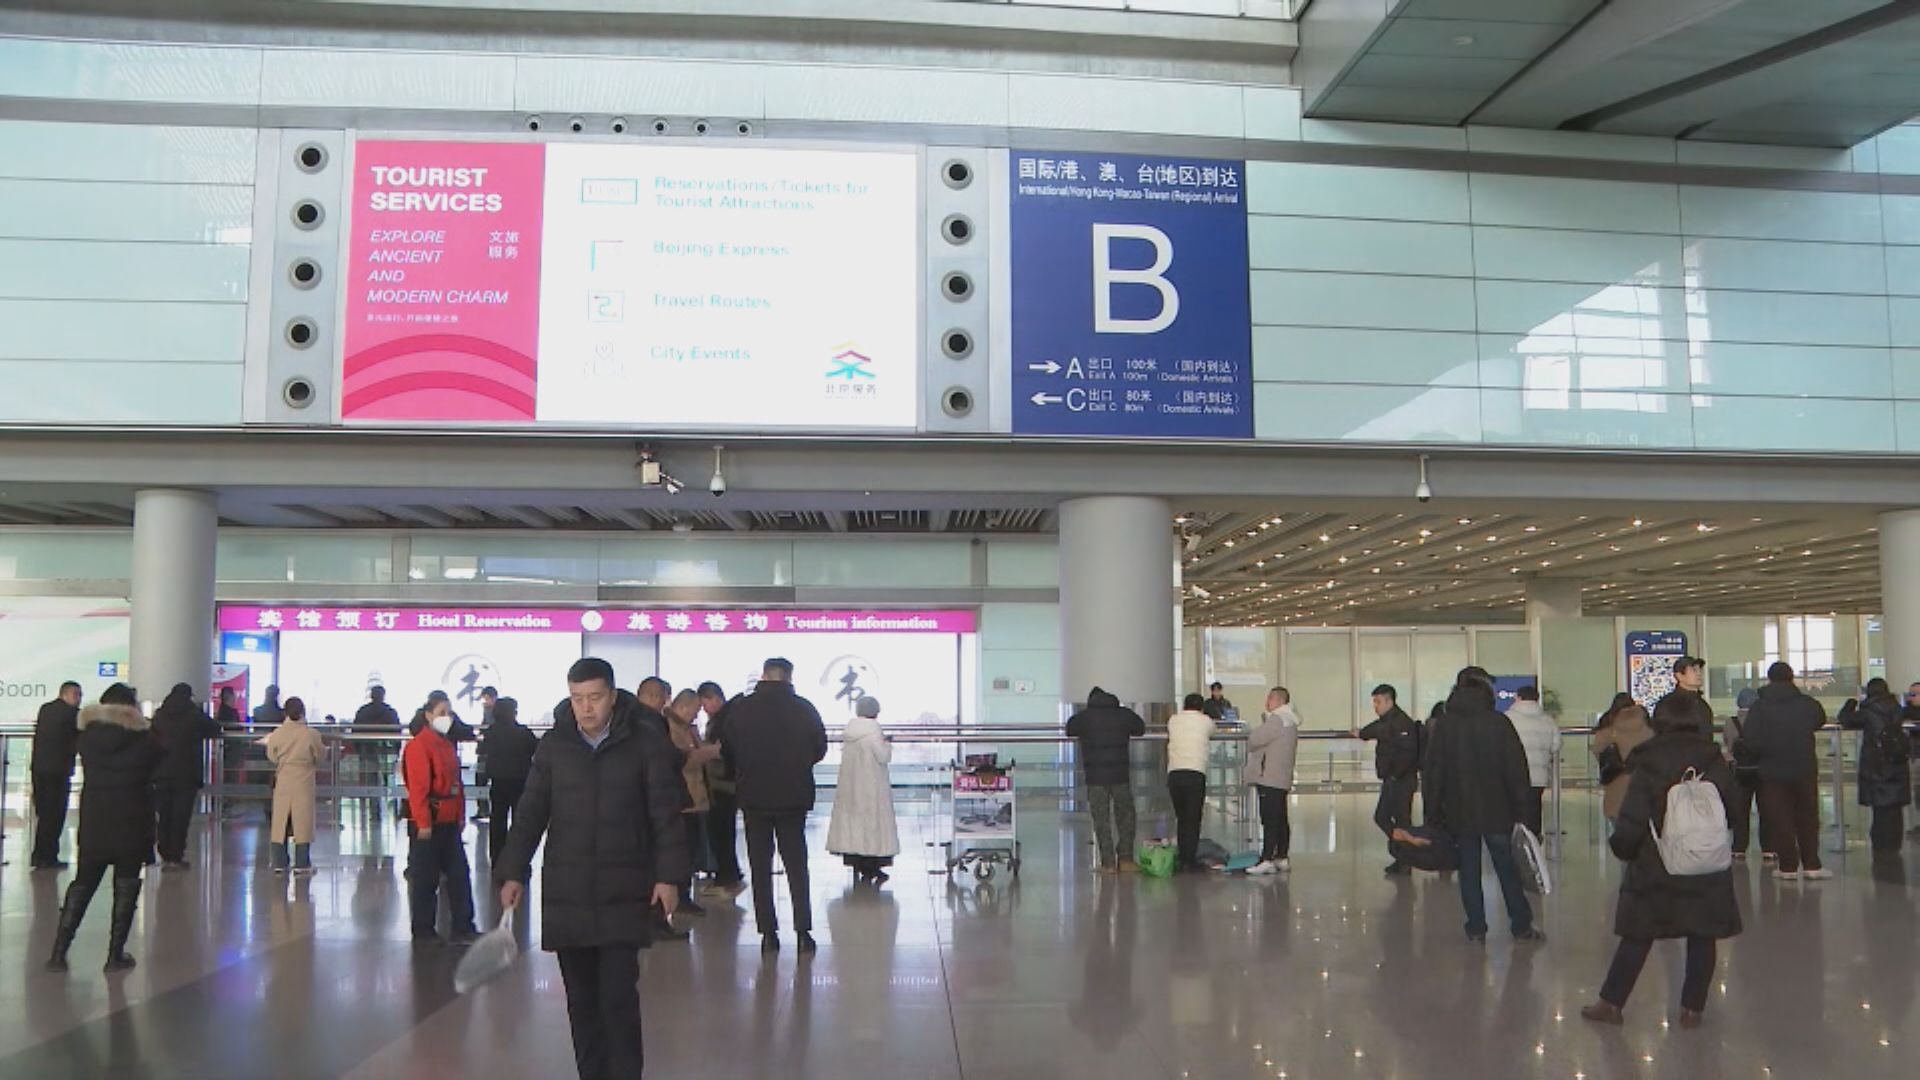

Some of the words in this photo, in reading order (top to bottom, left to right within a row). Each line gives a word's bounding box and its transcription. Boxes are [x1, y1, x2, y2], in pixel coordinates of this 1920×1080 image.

[371, 166, 488, 187] TOURIST
[847, 182, 869, 194] for
[370, 192, 503, 213] SERVICES
[655, 195, 713, 208] Tourist
[719, 196, 815, 210] Attractions
[370, 230, 446, 243] EXPLORE
[368, 250, 444, 264] ANCIENT
[652, 241, 713, 258] Beijing
[718, 242, 789, 258] Express
[367, 270, 405, 282] AND
[1093, 223, 1180, 333] B
[366, 290, 442, 304] MODERN
[446, 290, 508, 305] CHARM
[653, 294, 704, 308] Travel
[710, 295, 771, 309] Routes
[650, 347, 684, 362] City
[691, 347, 751, 361] Events
[1066, 357, 1085, 379] A
[1088, 358, 1112, 370] 出口
[1126, 359, 1158, 370] 100米
[1088, 371, 1105, 380] Exit
[1106, 371, 1116, 380] A
[1122, 371, 1148, 381] 100m
[1066, 388, 1086, 411] C
[1088, 389, 1112, 401] 出口
[1126, 390, 1152, 402] 80米
[1089, 402, 1106, 411] Exit
[1108, 402, 1117, 411] C
[418, 613, 460, 628] Hotel
[463, 613, 552, 628] Reservation
[627, 612, 769, 632] 旅游咨询
[784, 615, 847, 630] Tourism
[850, 615, 938, 630] information
